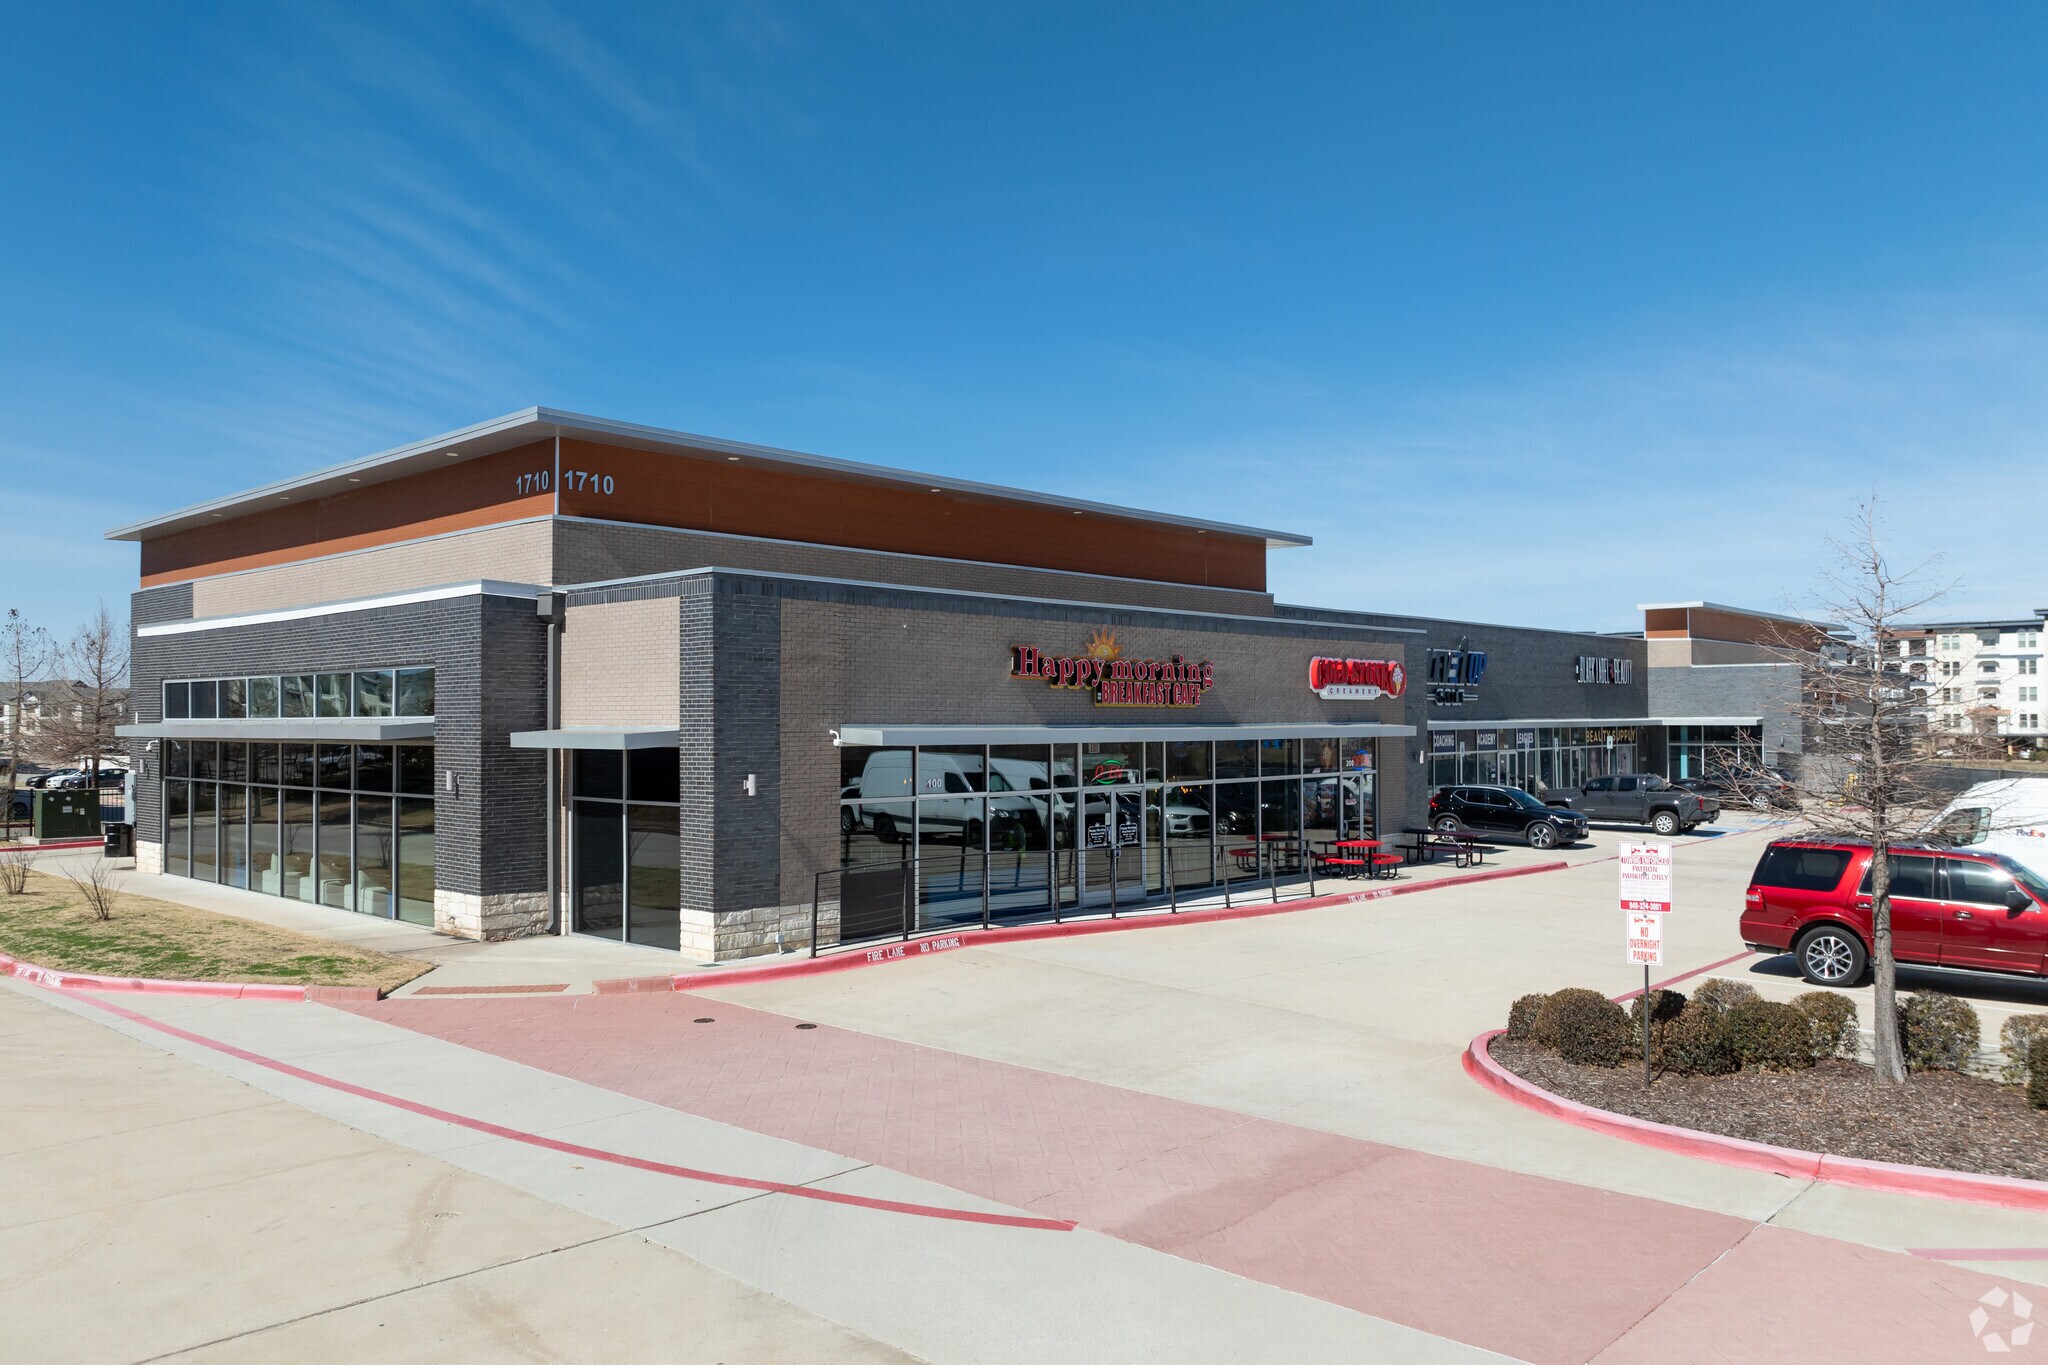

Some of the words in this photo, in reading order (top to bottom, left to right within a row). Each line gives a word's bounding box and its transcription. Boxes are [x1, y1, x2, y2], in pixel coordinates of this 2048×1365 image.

[516, 470, 549, 495] 1710
[564, 470, 614, 495] 1710
[1018, 646, 1105, 687] Happy
[1111, 654, 1214, 690] morning
[1315, 659, 1349, 690] COLD
[1347, 660, 1390, 690] STONE
[1467, 652, 1487, 685] UP
[1101, 680, 1171, 705] BREAKFAST
[1173, 683, 1201, 705] CAFE
[1329, 687, 1378, 695] CREAMERY
[1433, 734, 1455, 747] COACHING
[1477, 733, 1496, 745] ACADEMY
[1586, 730, 1611, 742] BEAUTY
[1611, 729, 1636, 741] SUPPLY
[1345, 759, 1354, 767] 200
[1095, 764, 1123, 780] OEN
[926, 778, 942, 788] 100
[1632, 865, 1658, 873] PATRON
[1640, 926, 1649, 938] NO
[866, 949, 884, 962] FIRE
[886, 946, 906, 959] LANE
[919, 943, 930, 953] NO
[931, 937, 960, 951] PARKING
[1629, 938, 1660, 950] OVERNIGHT
[1633, 950, 1657, 962] PARKING
